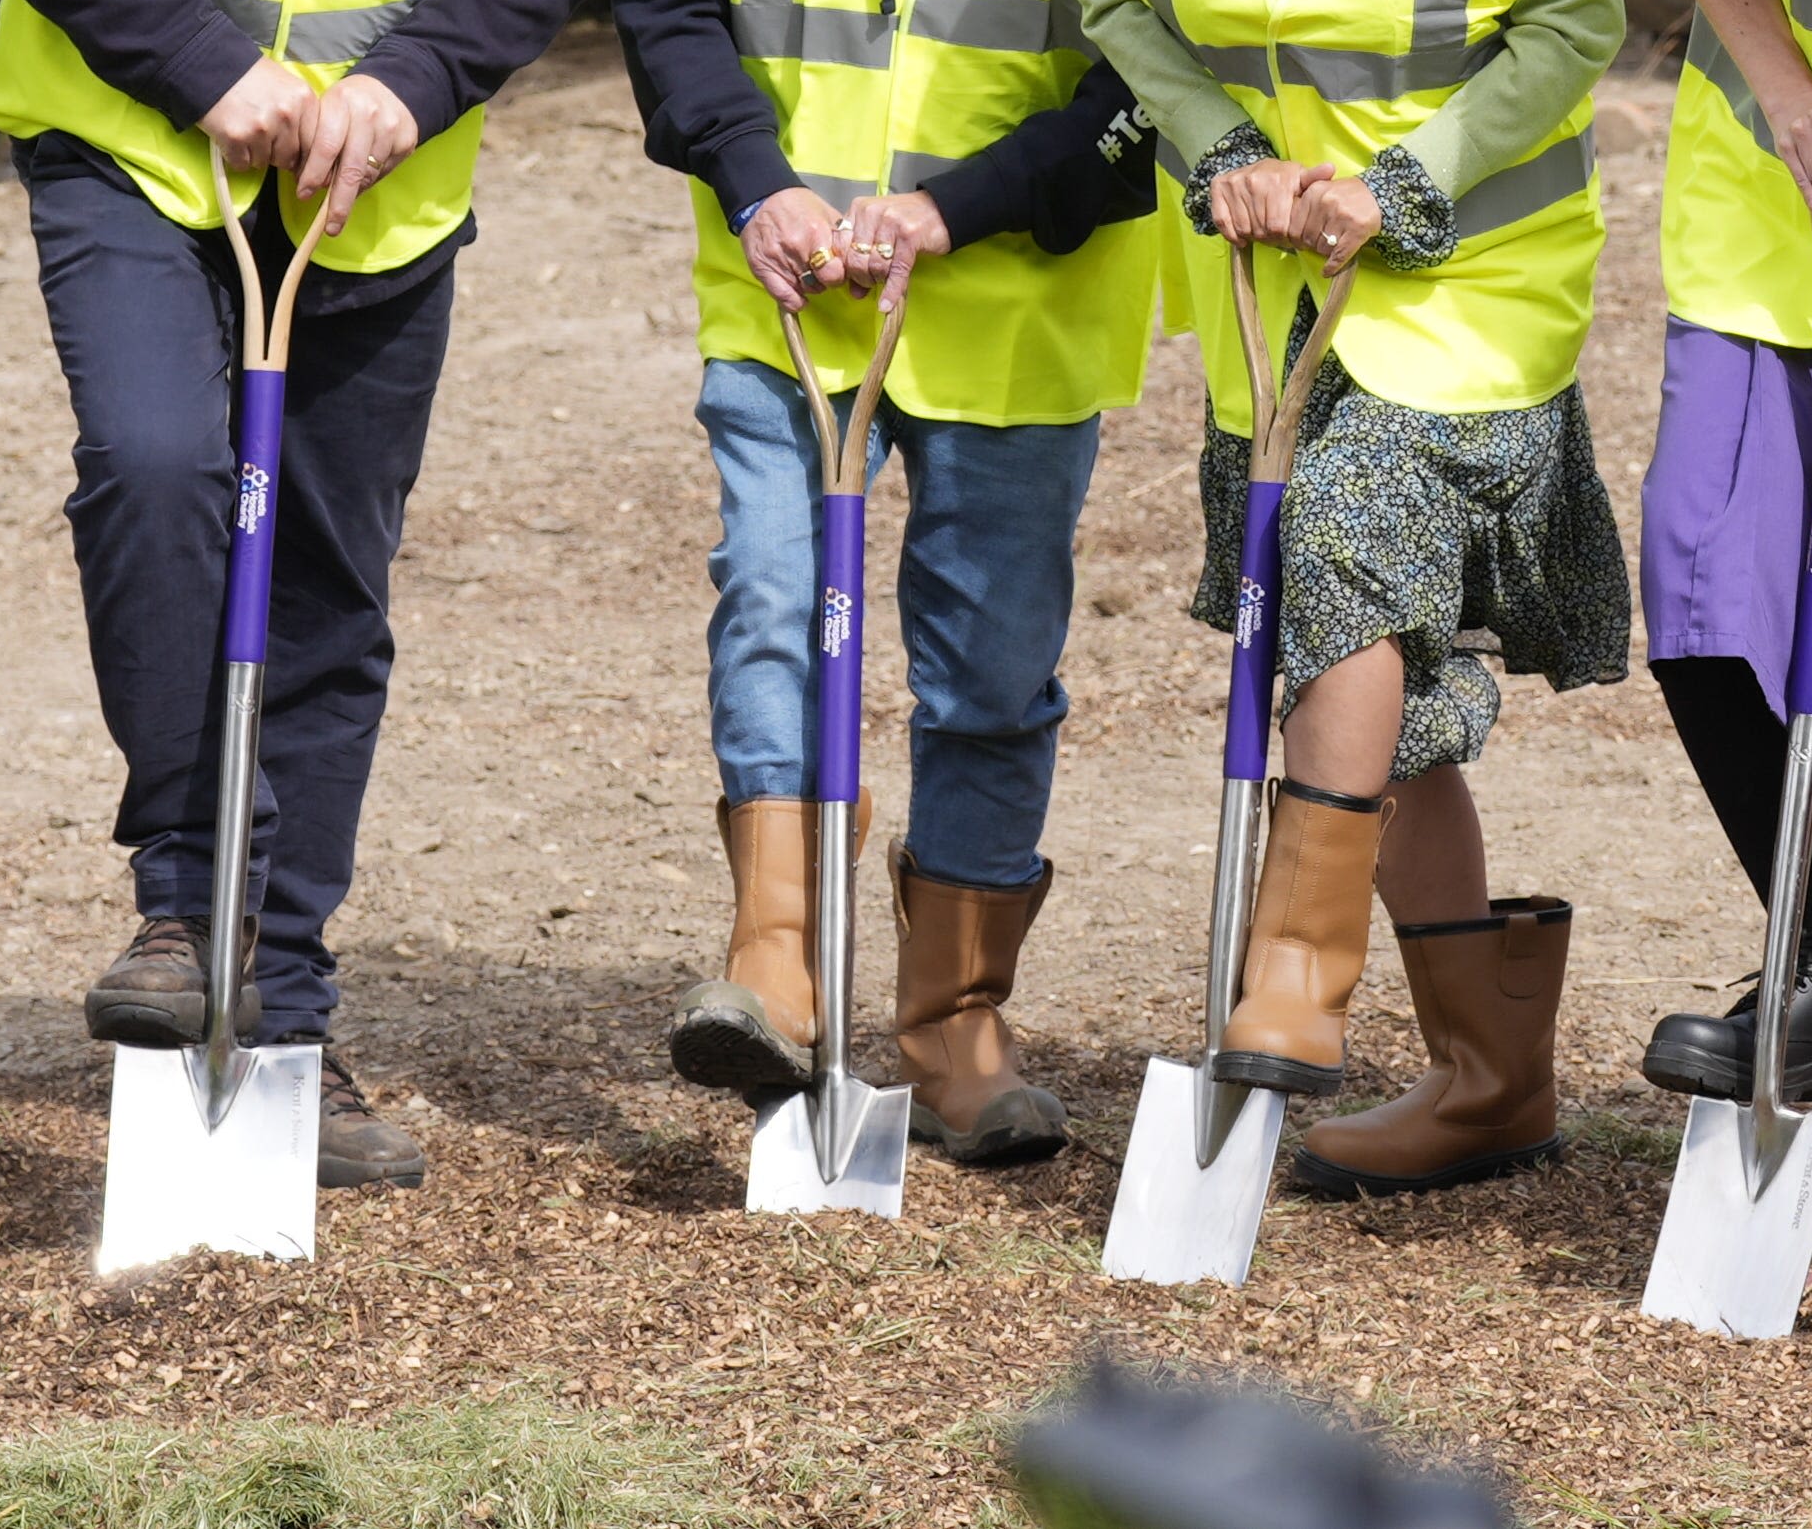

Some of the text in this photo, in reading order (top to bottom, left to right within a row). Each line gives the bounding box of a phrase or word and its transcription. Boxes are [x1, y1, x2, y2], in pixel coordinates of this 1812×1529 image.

[237, 493, 249, 529] Charity
[246, 491, 258, 534] Hospitals
[257, 488, 268, 516] Leeds
[823, 617, 833, 652] Charity
[841, 611, 851, 640] Leeds
[1236, 607, 1246, 643] Charity
[1242, 605, 1254, 649] Hospitals
[1254, 602, 1264, 631] Leeds
[830, 615, 841, 658] Hospitals
